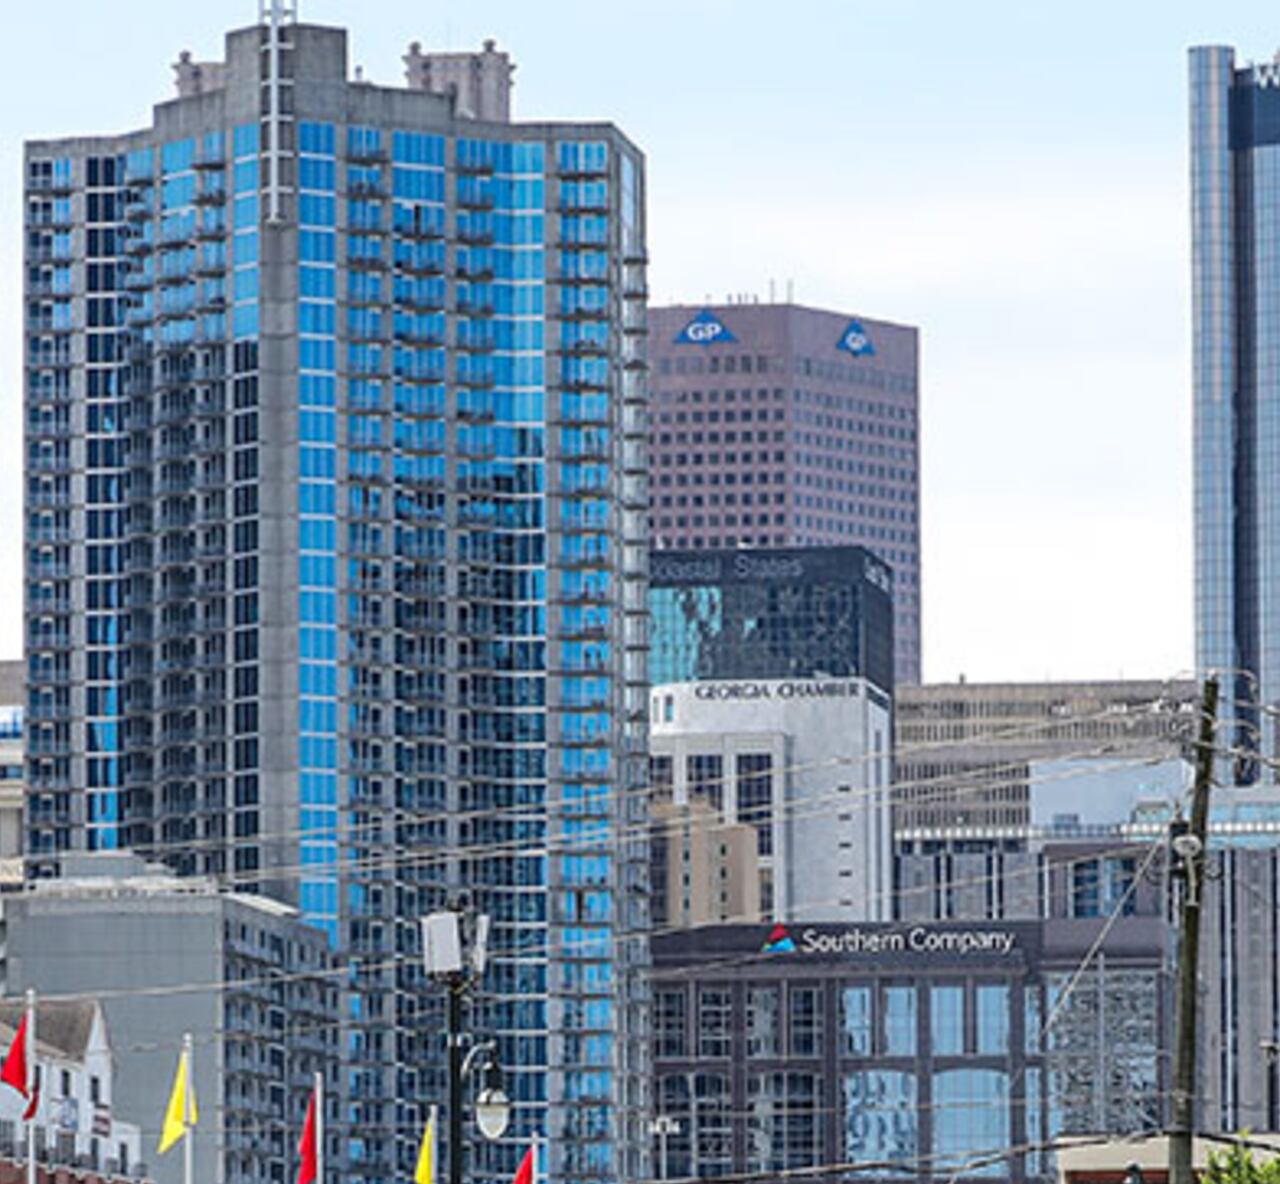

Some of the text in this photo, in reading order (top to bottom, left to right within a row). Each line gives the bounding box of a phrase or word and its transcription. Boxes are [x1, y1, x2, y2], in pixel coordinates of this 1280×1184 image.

[687, 322, 722, 341] GP
[734, 553, 804, 580] States
[695, 682, 861, 700] GEORGIA CHAMBER
[802, 927, 1015, 955] Southern Company
